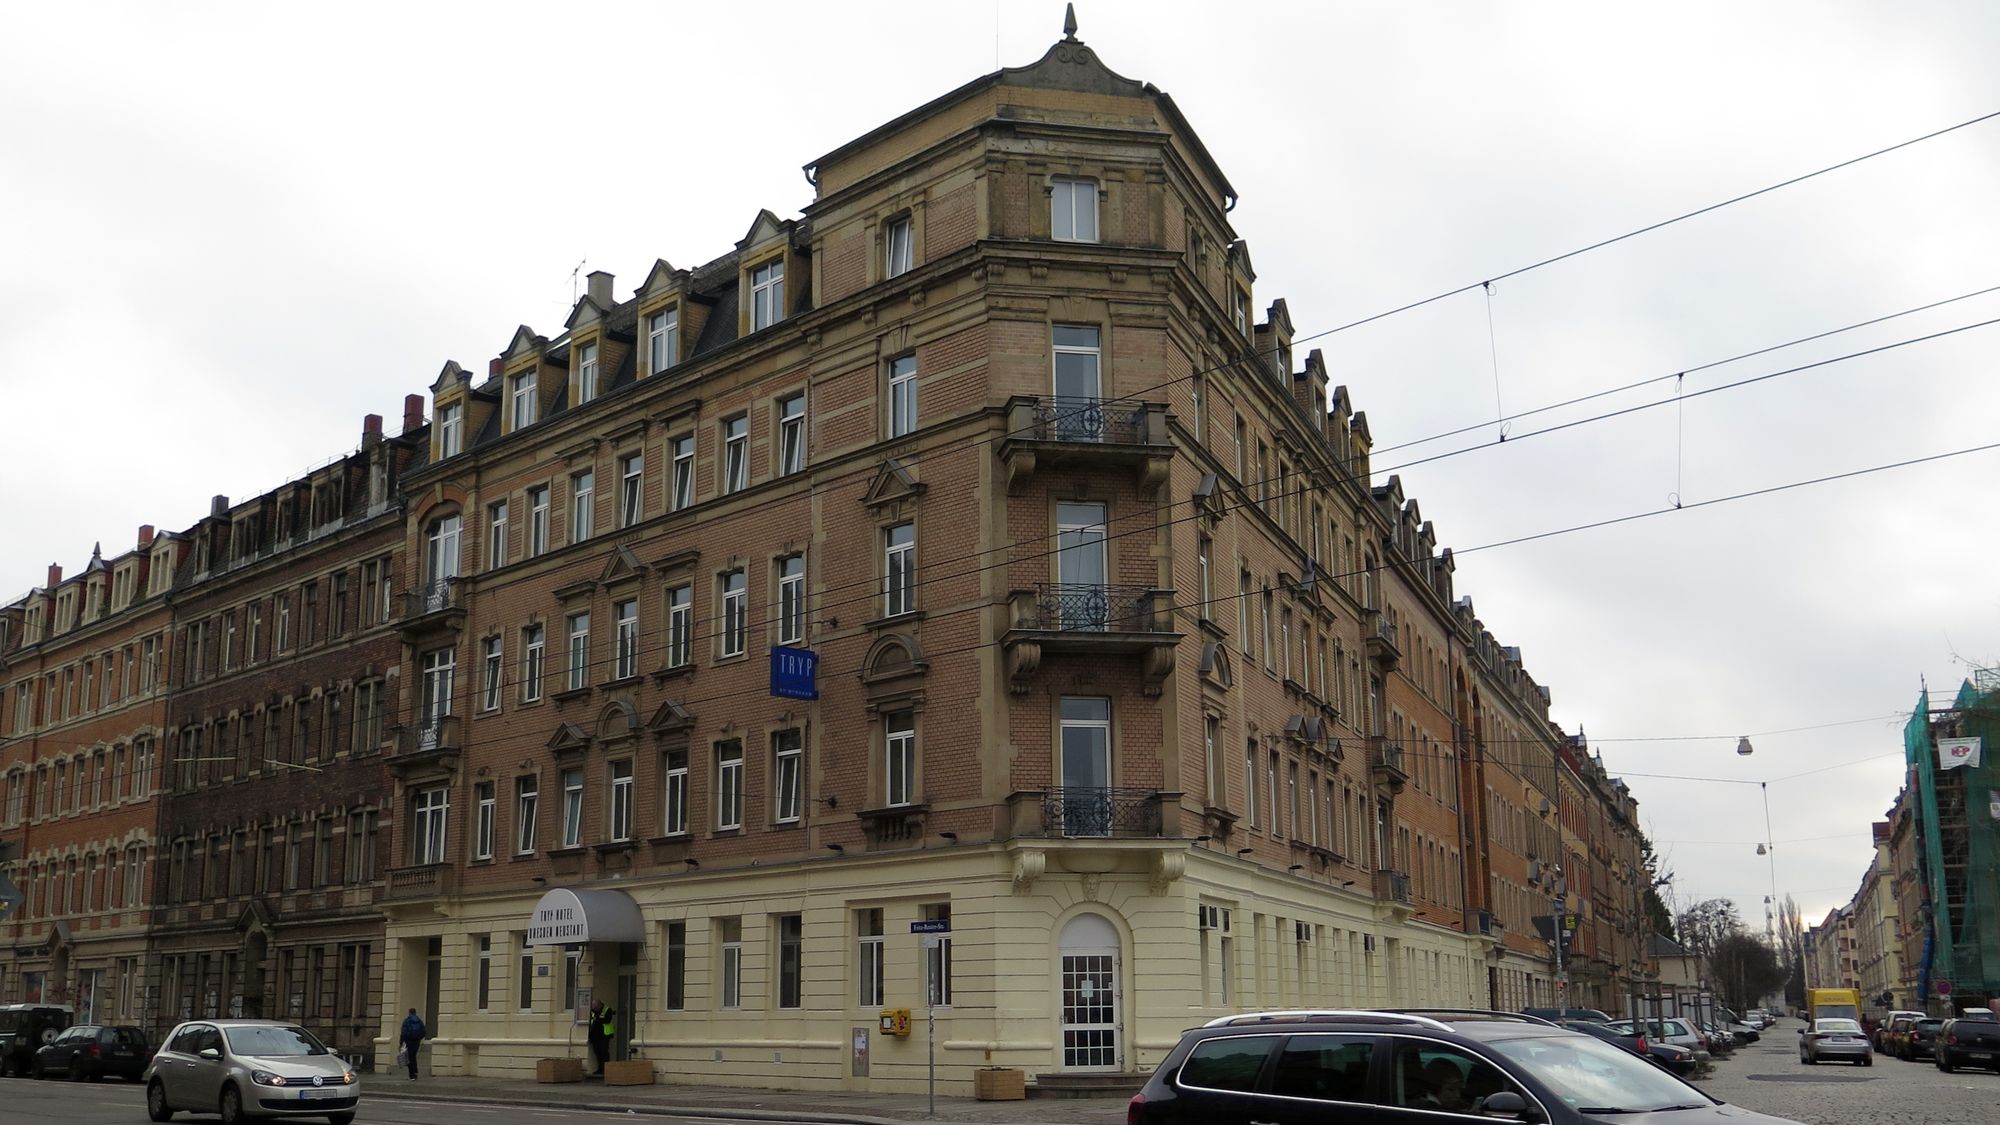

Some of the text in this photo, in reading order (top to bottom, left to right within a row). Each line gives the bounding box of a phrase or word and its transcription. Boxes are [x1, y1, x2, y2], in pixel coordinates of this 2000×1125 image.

[780, 654, 812, 677] TRYP
[540, 908, 573, 922] TRYP HOTEL
[529, 923, 584, 939] DRESDEN NEUSTADT
